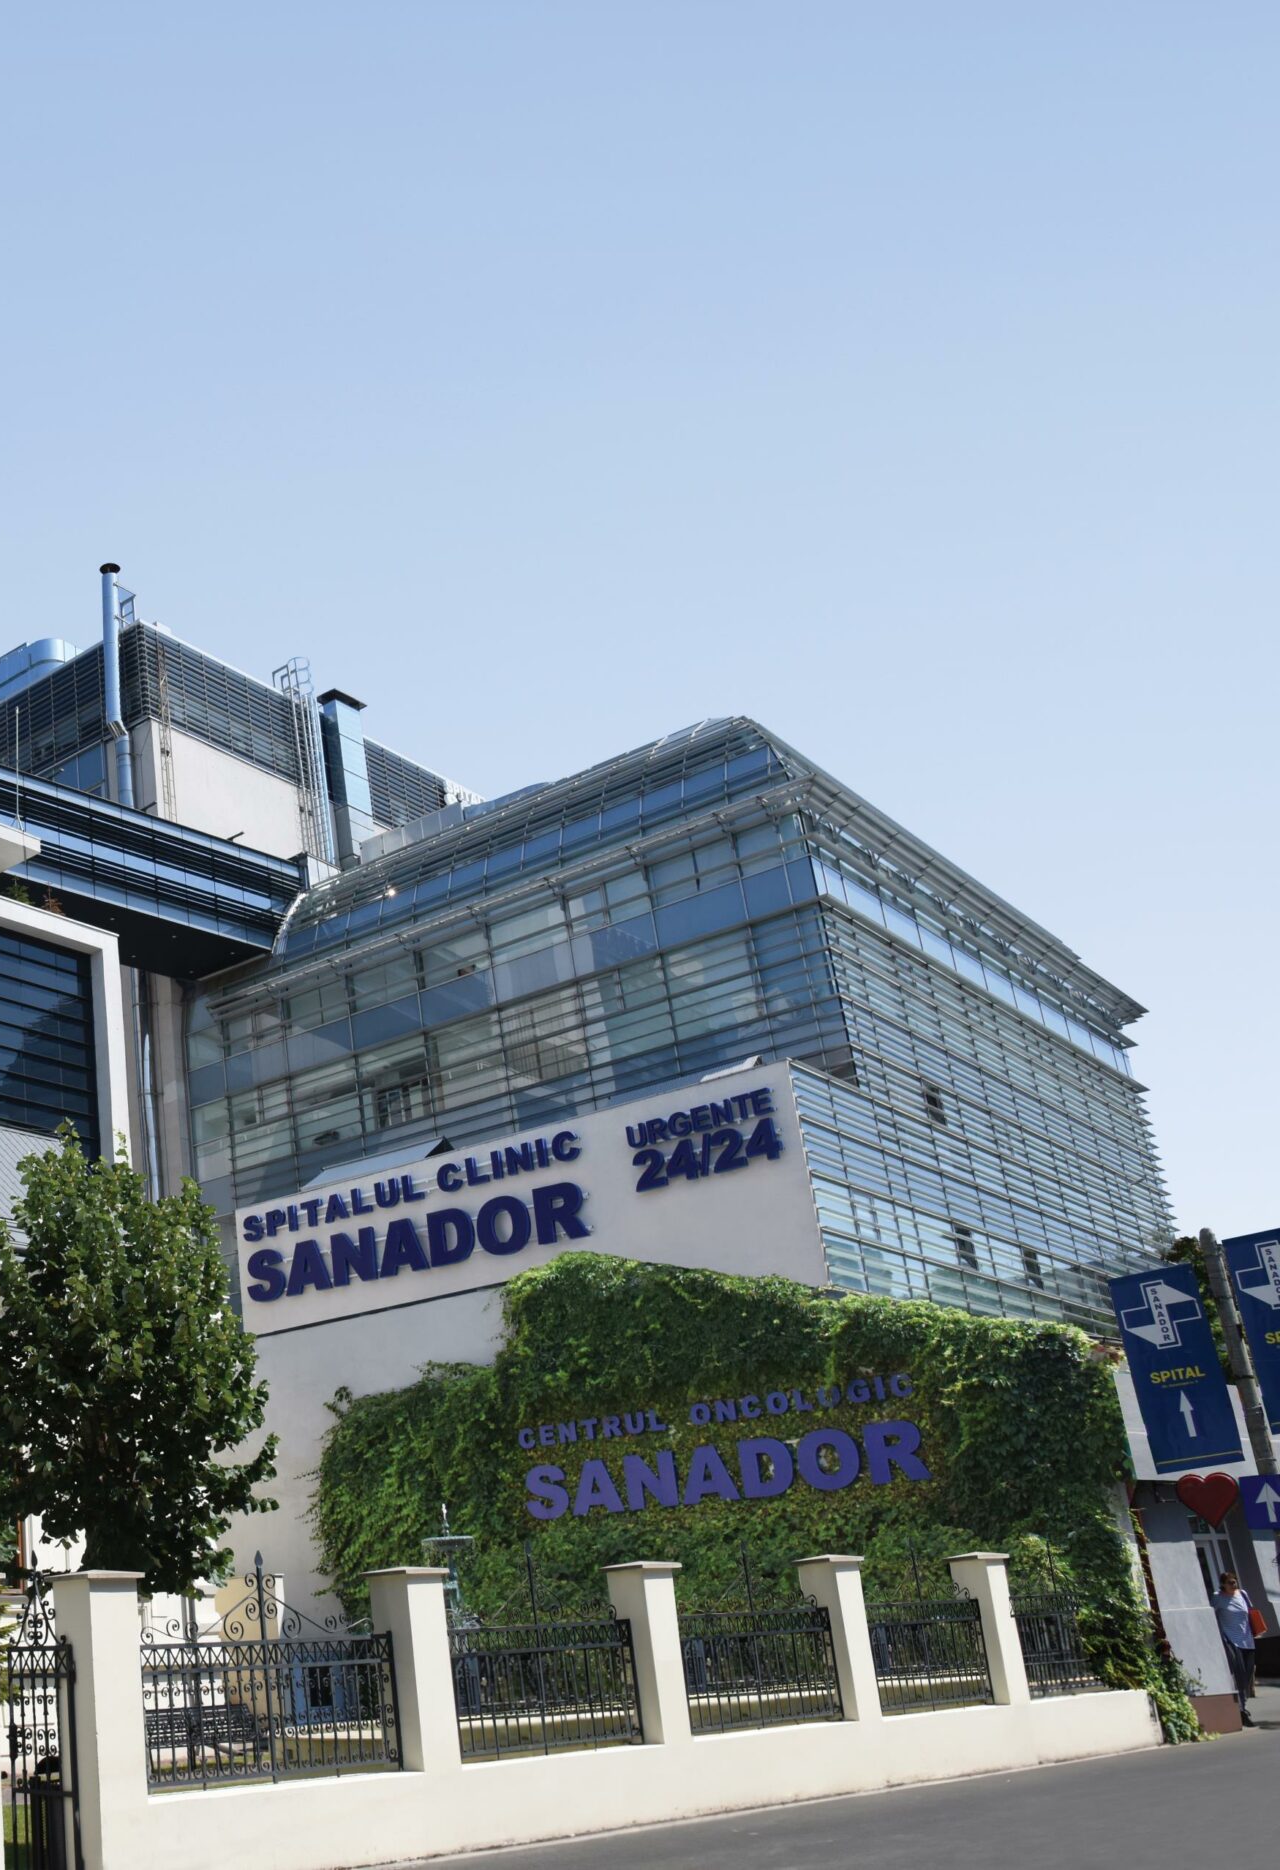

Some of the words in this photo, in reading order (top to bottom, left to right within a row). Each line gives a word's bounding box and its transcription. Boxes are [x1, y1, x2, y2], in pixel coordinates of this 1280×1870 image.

[625, 1087, 776, 1148] URGENTE
[632, 1117, 783, 1192] 24/24
[243, 1175, 426, 1242] SPITALUL
[436, 1130, 582, 1192] CLINIC
[247, 1181, 591, 1303] SANADOR
[1265, 1248, 1280, 1302] SANAD
[1150, 1288, 1171, 1341] SANADOR
[519, 1408, 667, 1449] CENTRUL
[689, 1373, 913, 1425] ONCOLOGIC
[1150, 1366, 1206, 1384] SPITAL
[524, 1420, 932, 1520] SANADOR
